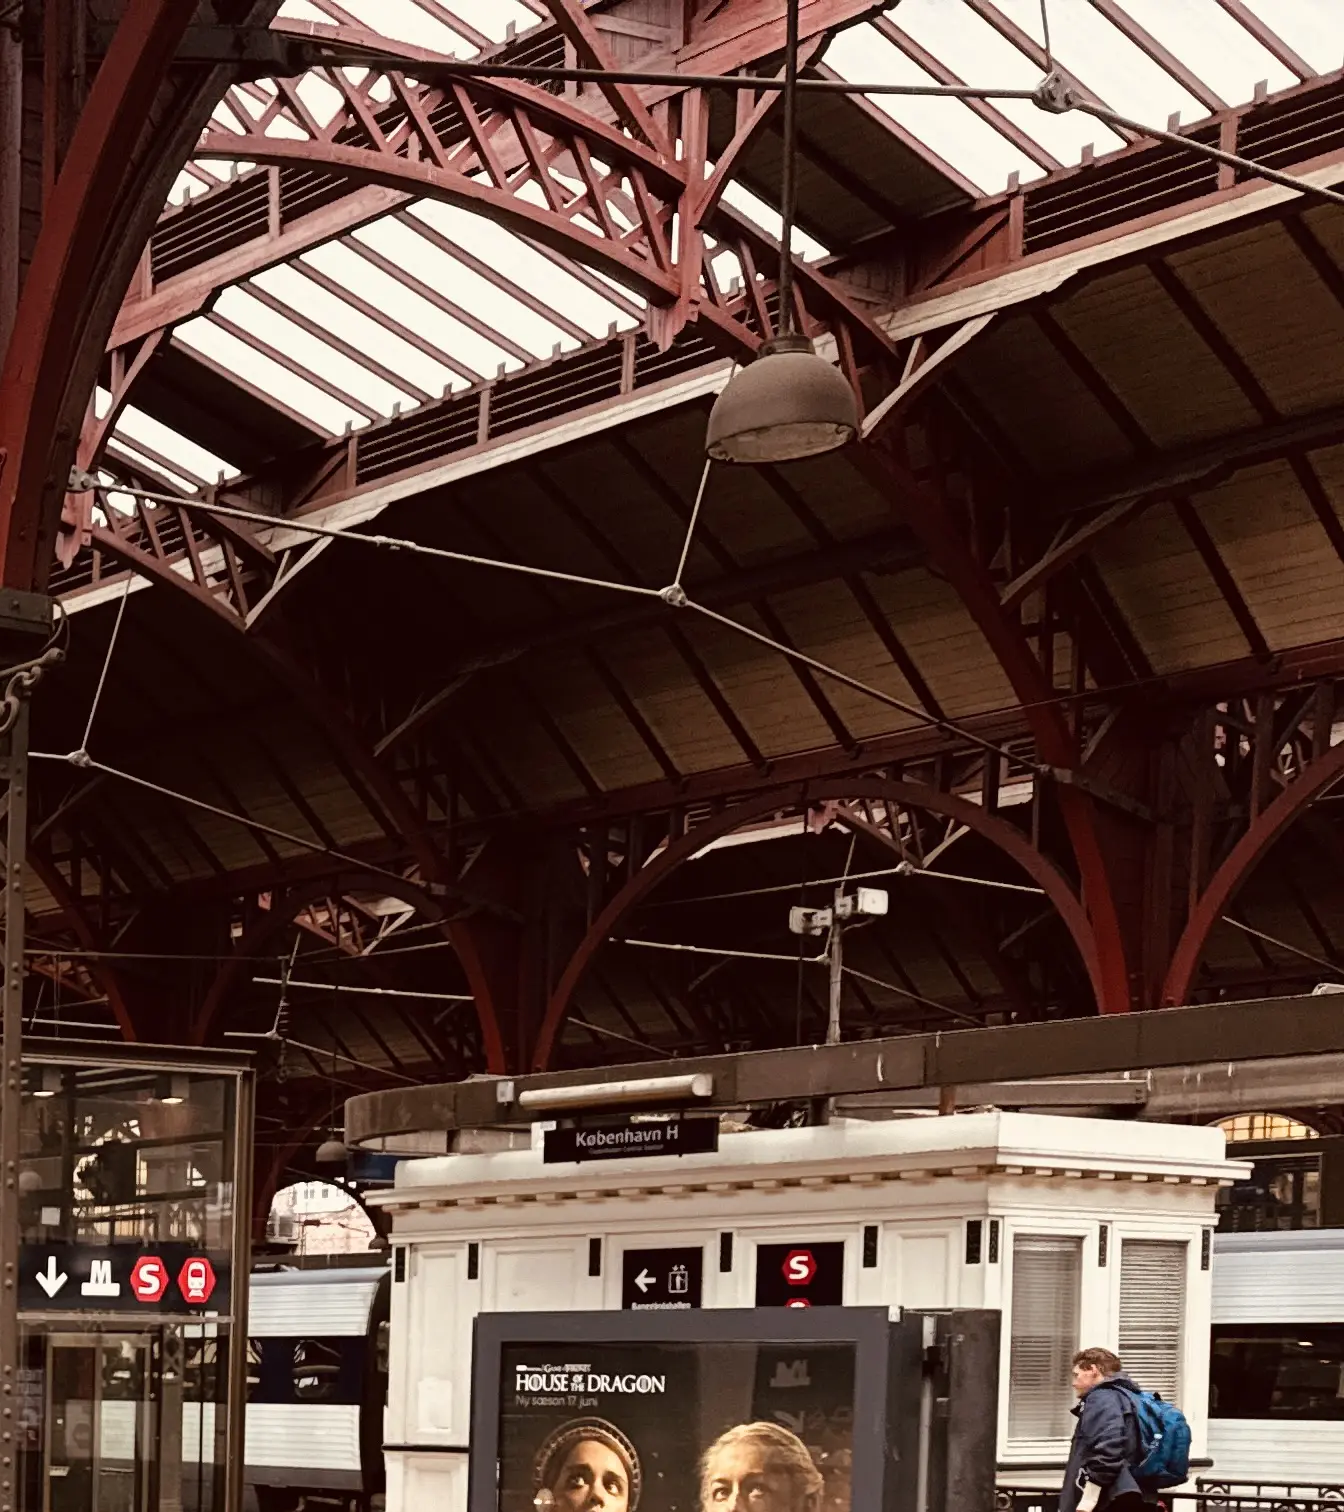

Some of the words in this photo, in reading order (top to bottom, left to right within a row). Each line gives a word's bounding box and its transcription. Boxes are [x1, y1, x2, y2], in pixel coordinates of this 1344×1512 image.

[576, 1128, 661, 1147] København
[666, 1125, 678, 1140] H
[789, 1256, 810, 1280] S
[138, 1264, 160, 1295] S
[515, 1373, 569, 1392] HOUSE
[587, 1374, 666, 1393] DRAGON
[515, 1395, 529, 1407] Ny
[578, 1395, 598, 1409] juni
